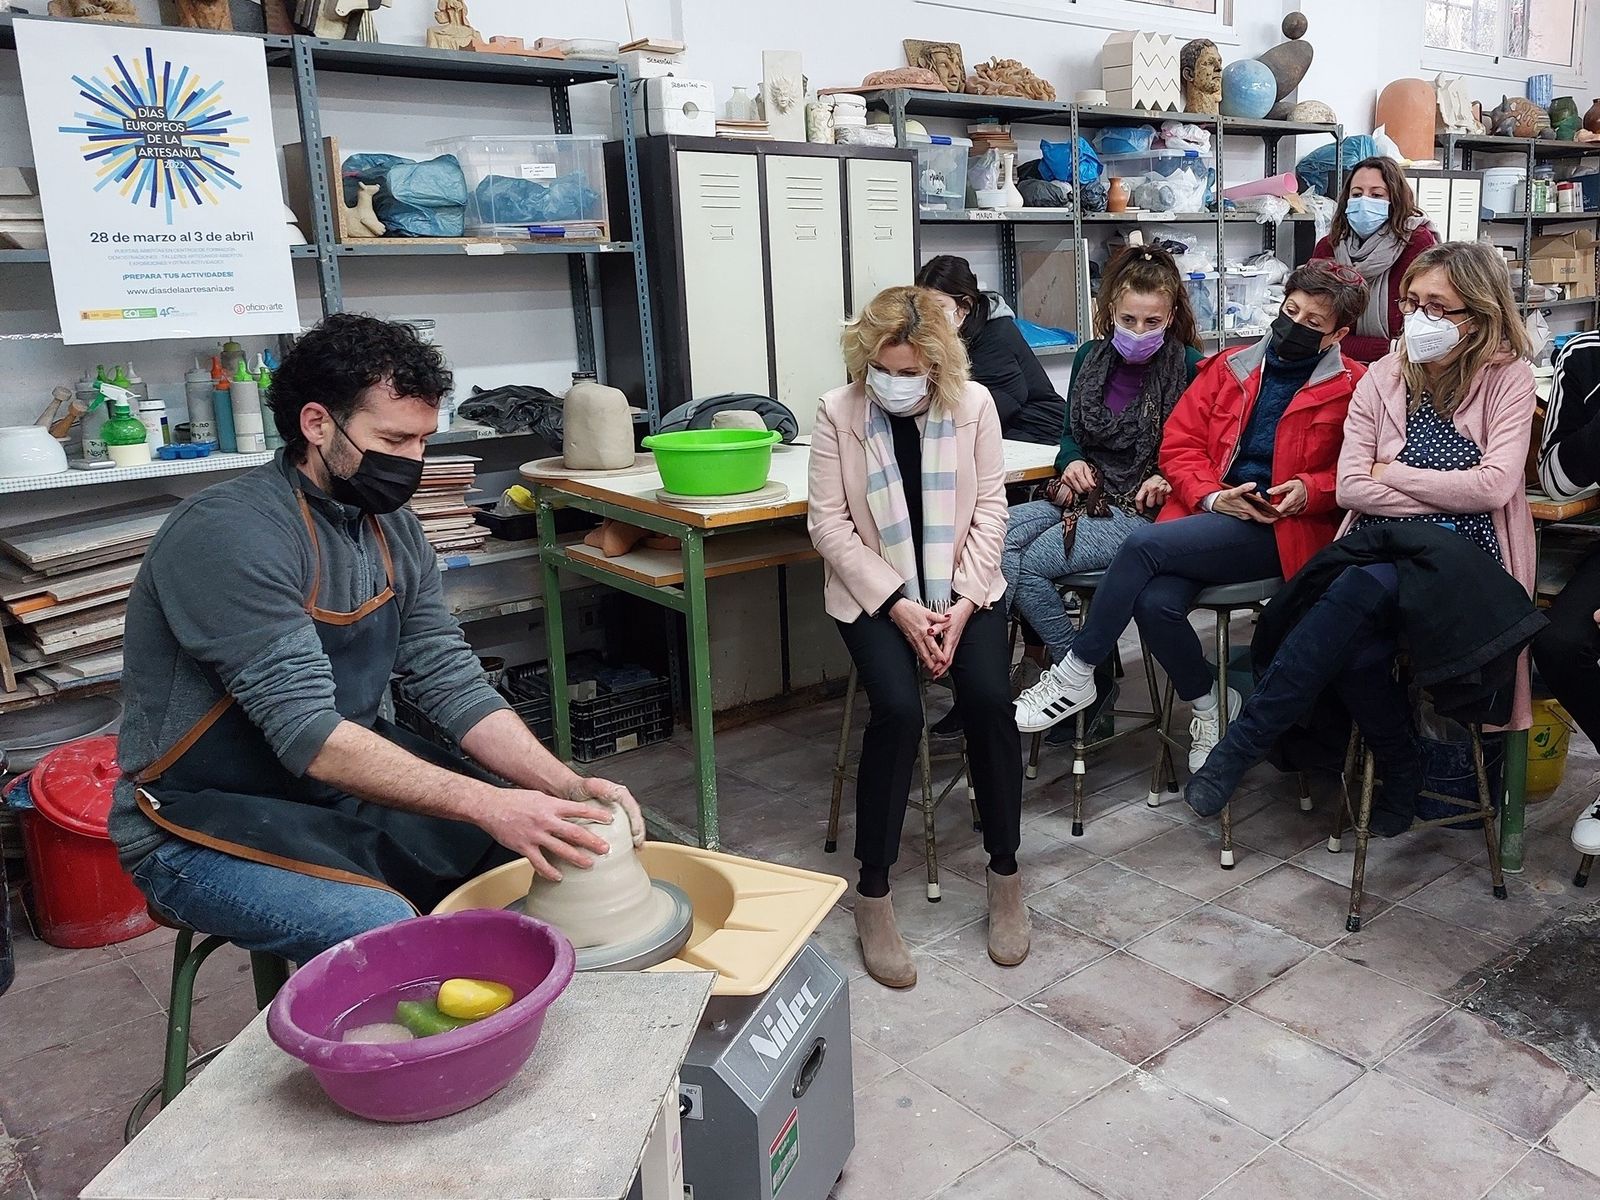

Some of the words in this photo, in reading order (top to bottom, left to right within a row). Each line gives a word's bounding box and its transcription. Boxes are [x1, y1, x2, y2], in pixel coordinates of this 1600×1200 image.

[138, 106, 165, 119] DÍAS
[125, 120, 185, 132] EUROPEOS
[147, 134, 162, 144] DE
[164, 134, 180, 145] LA
[138, 146, 201, 158] ARTESANÍA
[164, 160, 185, 169] 2022
[90, 231, 109, 243] 28
[112, 231, 130, 243] de
[133, 233, 177, 242] marzo
[180, 231, 192, 242] al
[194, 231, 203, 241] 3
[205, 231, 222, 241] de
[225, 230, 254, 241] abril
[126, 284, 235, 295] www.diasdelaartesania.es
[748, 976, 822, 1072] Nidec
